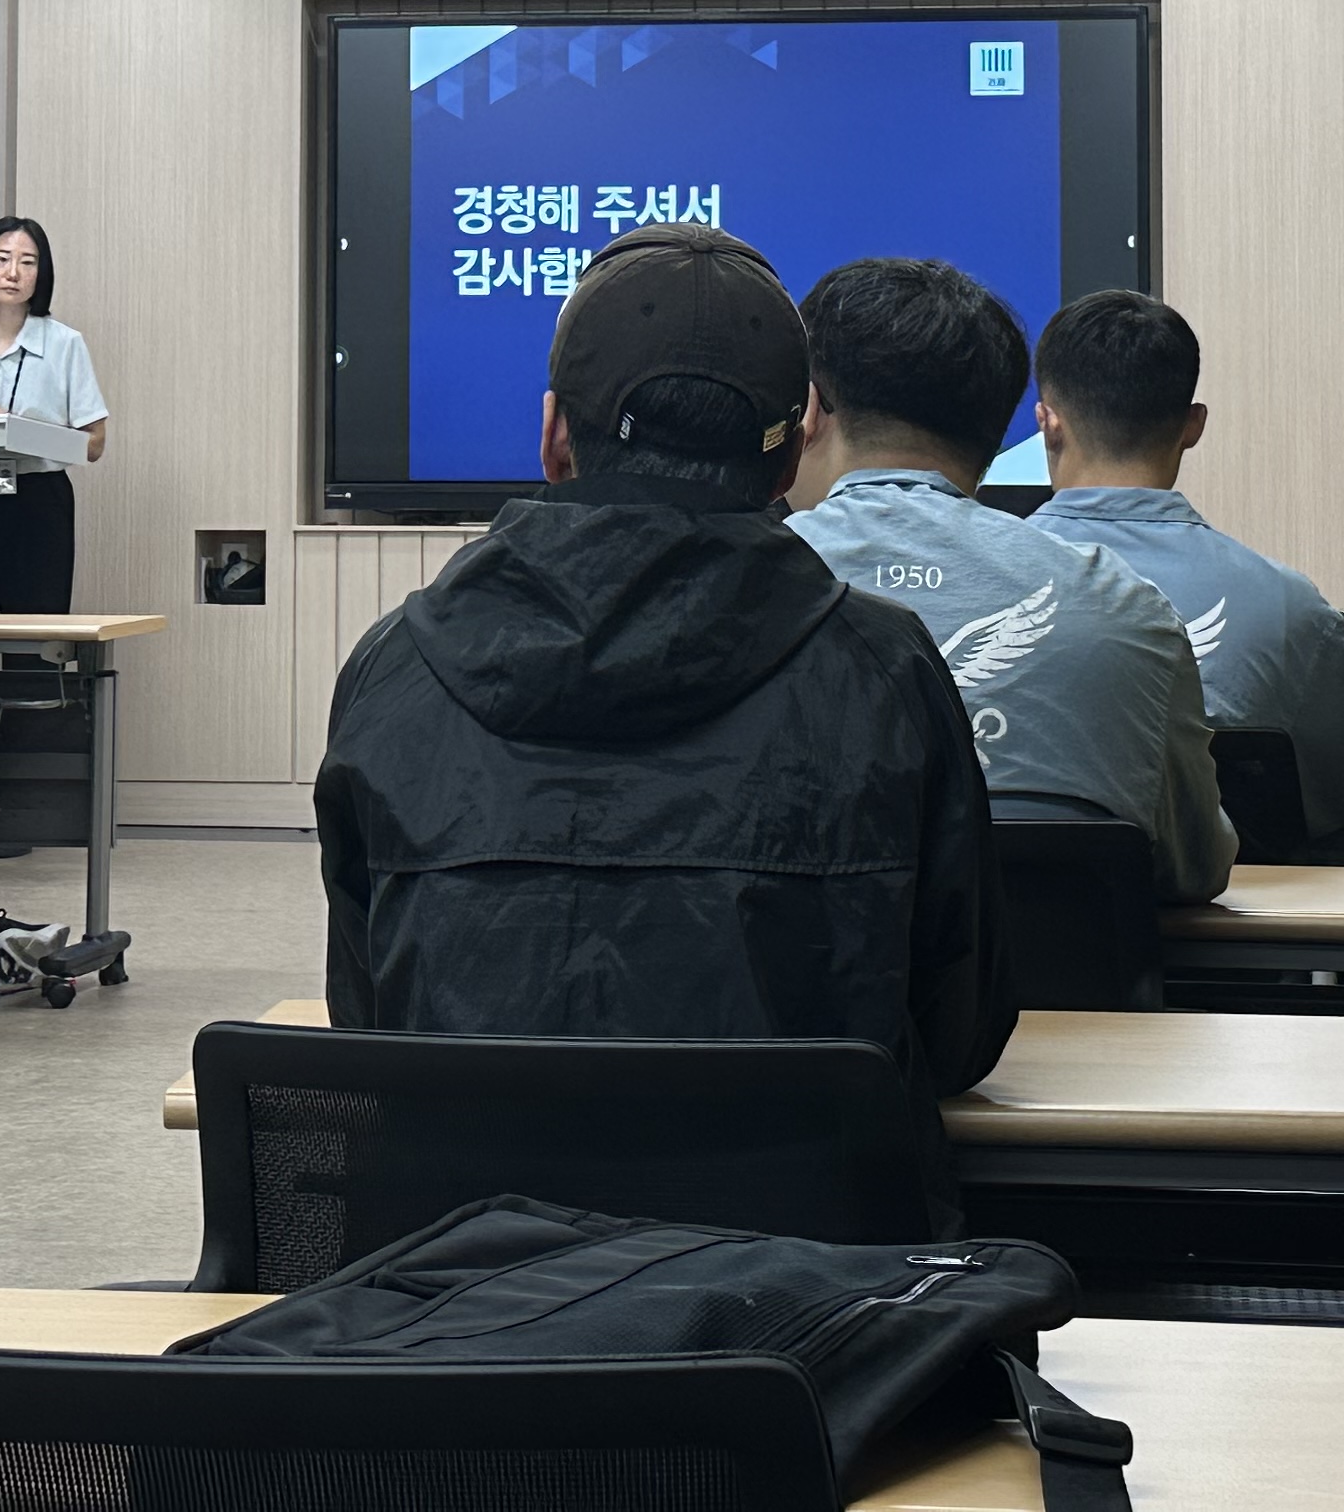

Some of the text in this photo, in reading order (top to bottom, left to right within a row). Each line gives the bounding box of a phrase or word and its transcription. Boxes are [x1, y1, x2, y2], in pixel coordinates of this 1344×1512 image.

[453, 184, 721, 235] 경청해 주셔서
[875, 564, 943, 589] 1950
